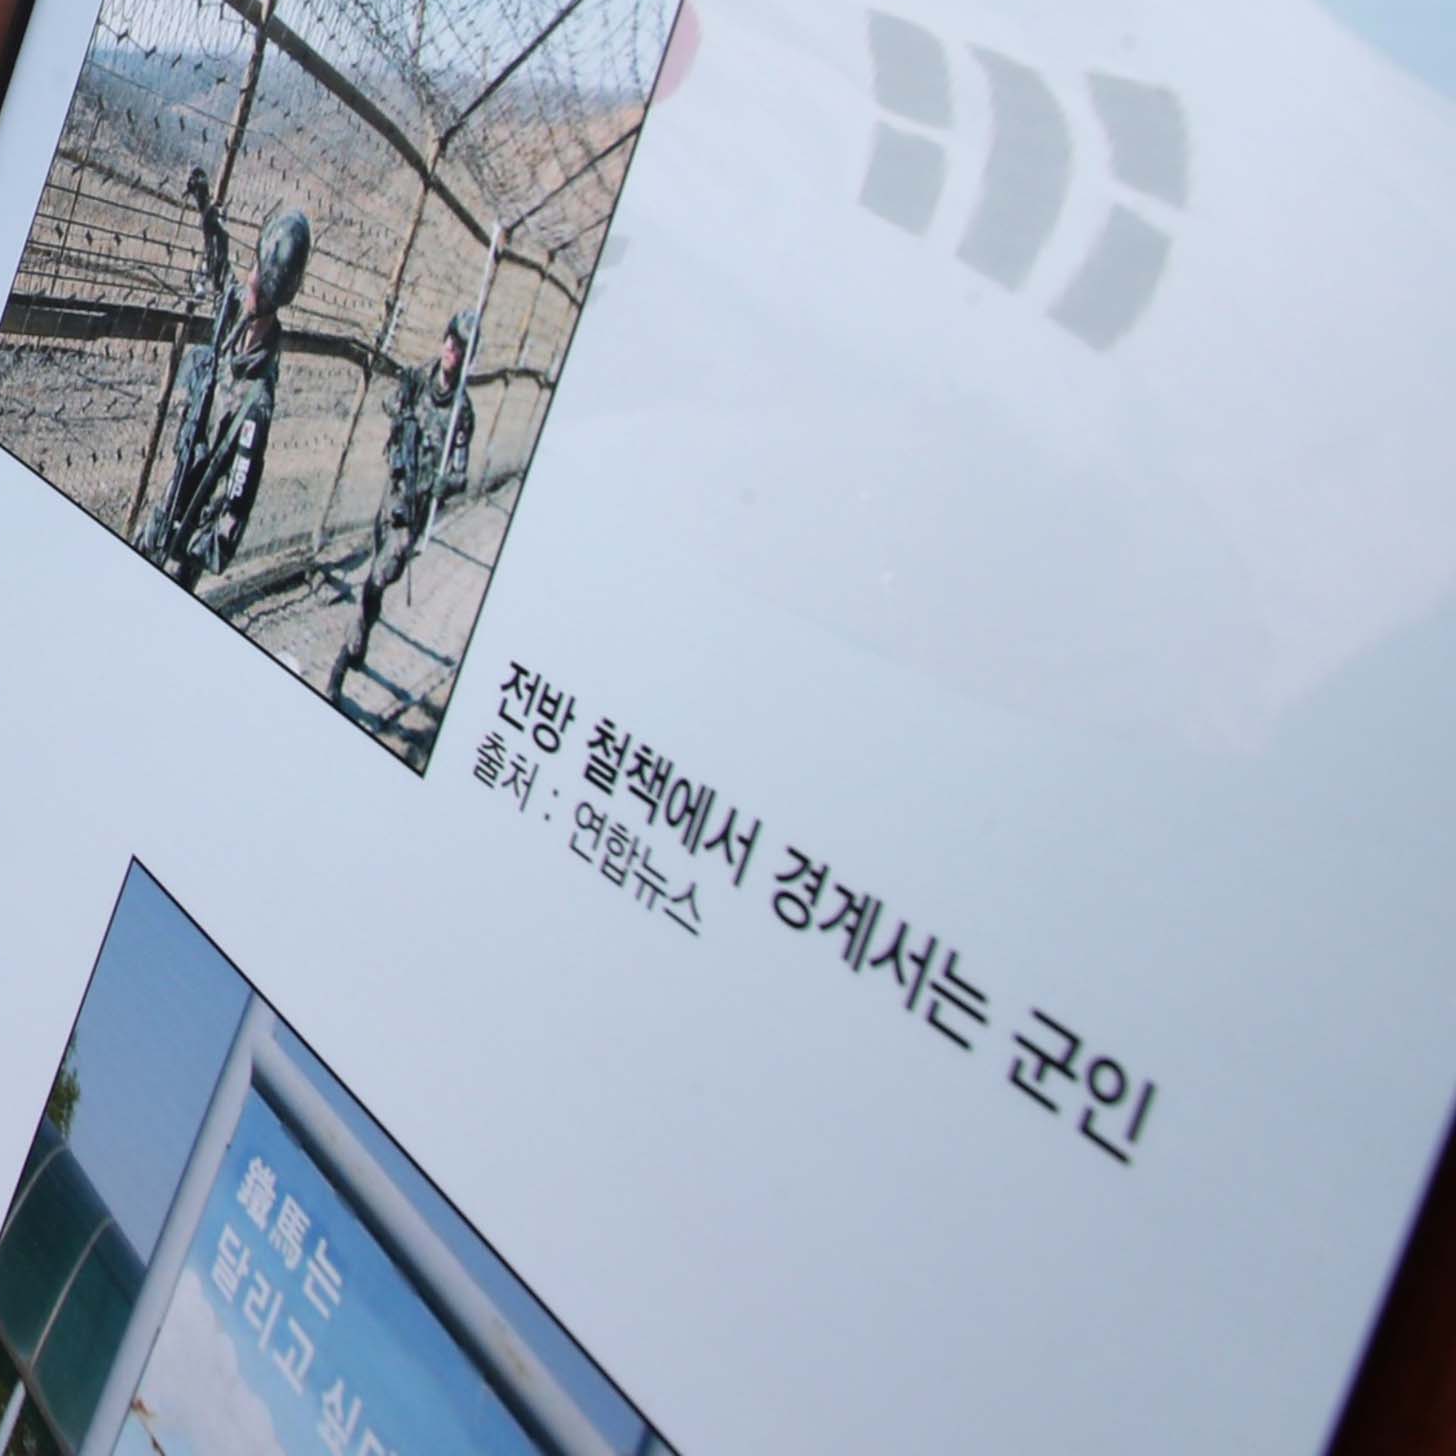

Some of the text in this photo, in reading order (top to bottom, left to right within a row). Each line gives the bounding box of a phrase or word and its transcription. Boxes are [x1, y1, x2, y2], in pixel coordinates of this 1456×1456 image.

[473, 731, 540, 812] 출처
[568, 800, 704, 937] 연합뉴스
[498, 660, 1156, 1166] 전방 철책에서 경계서는 군인
[211, 1222, 316, 1397] 달리고
